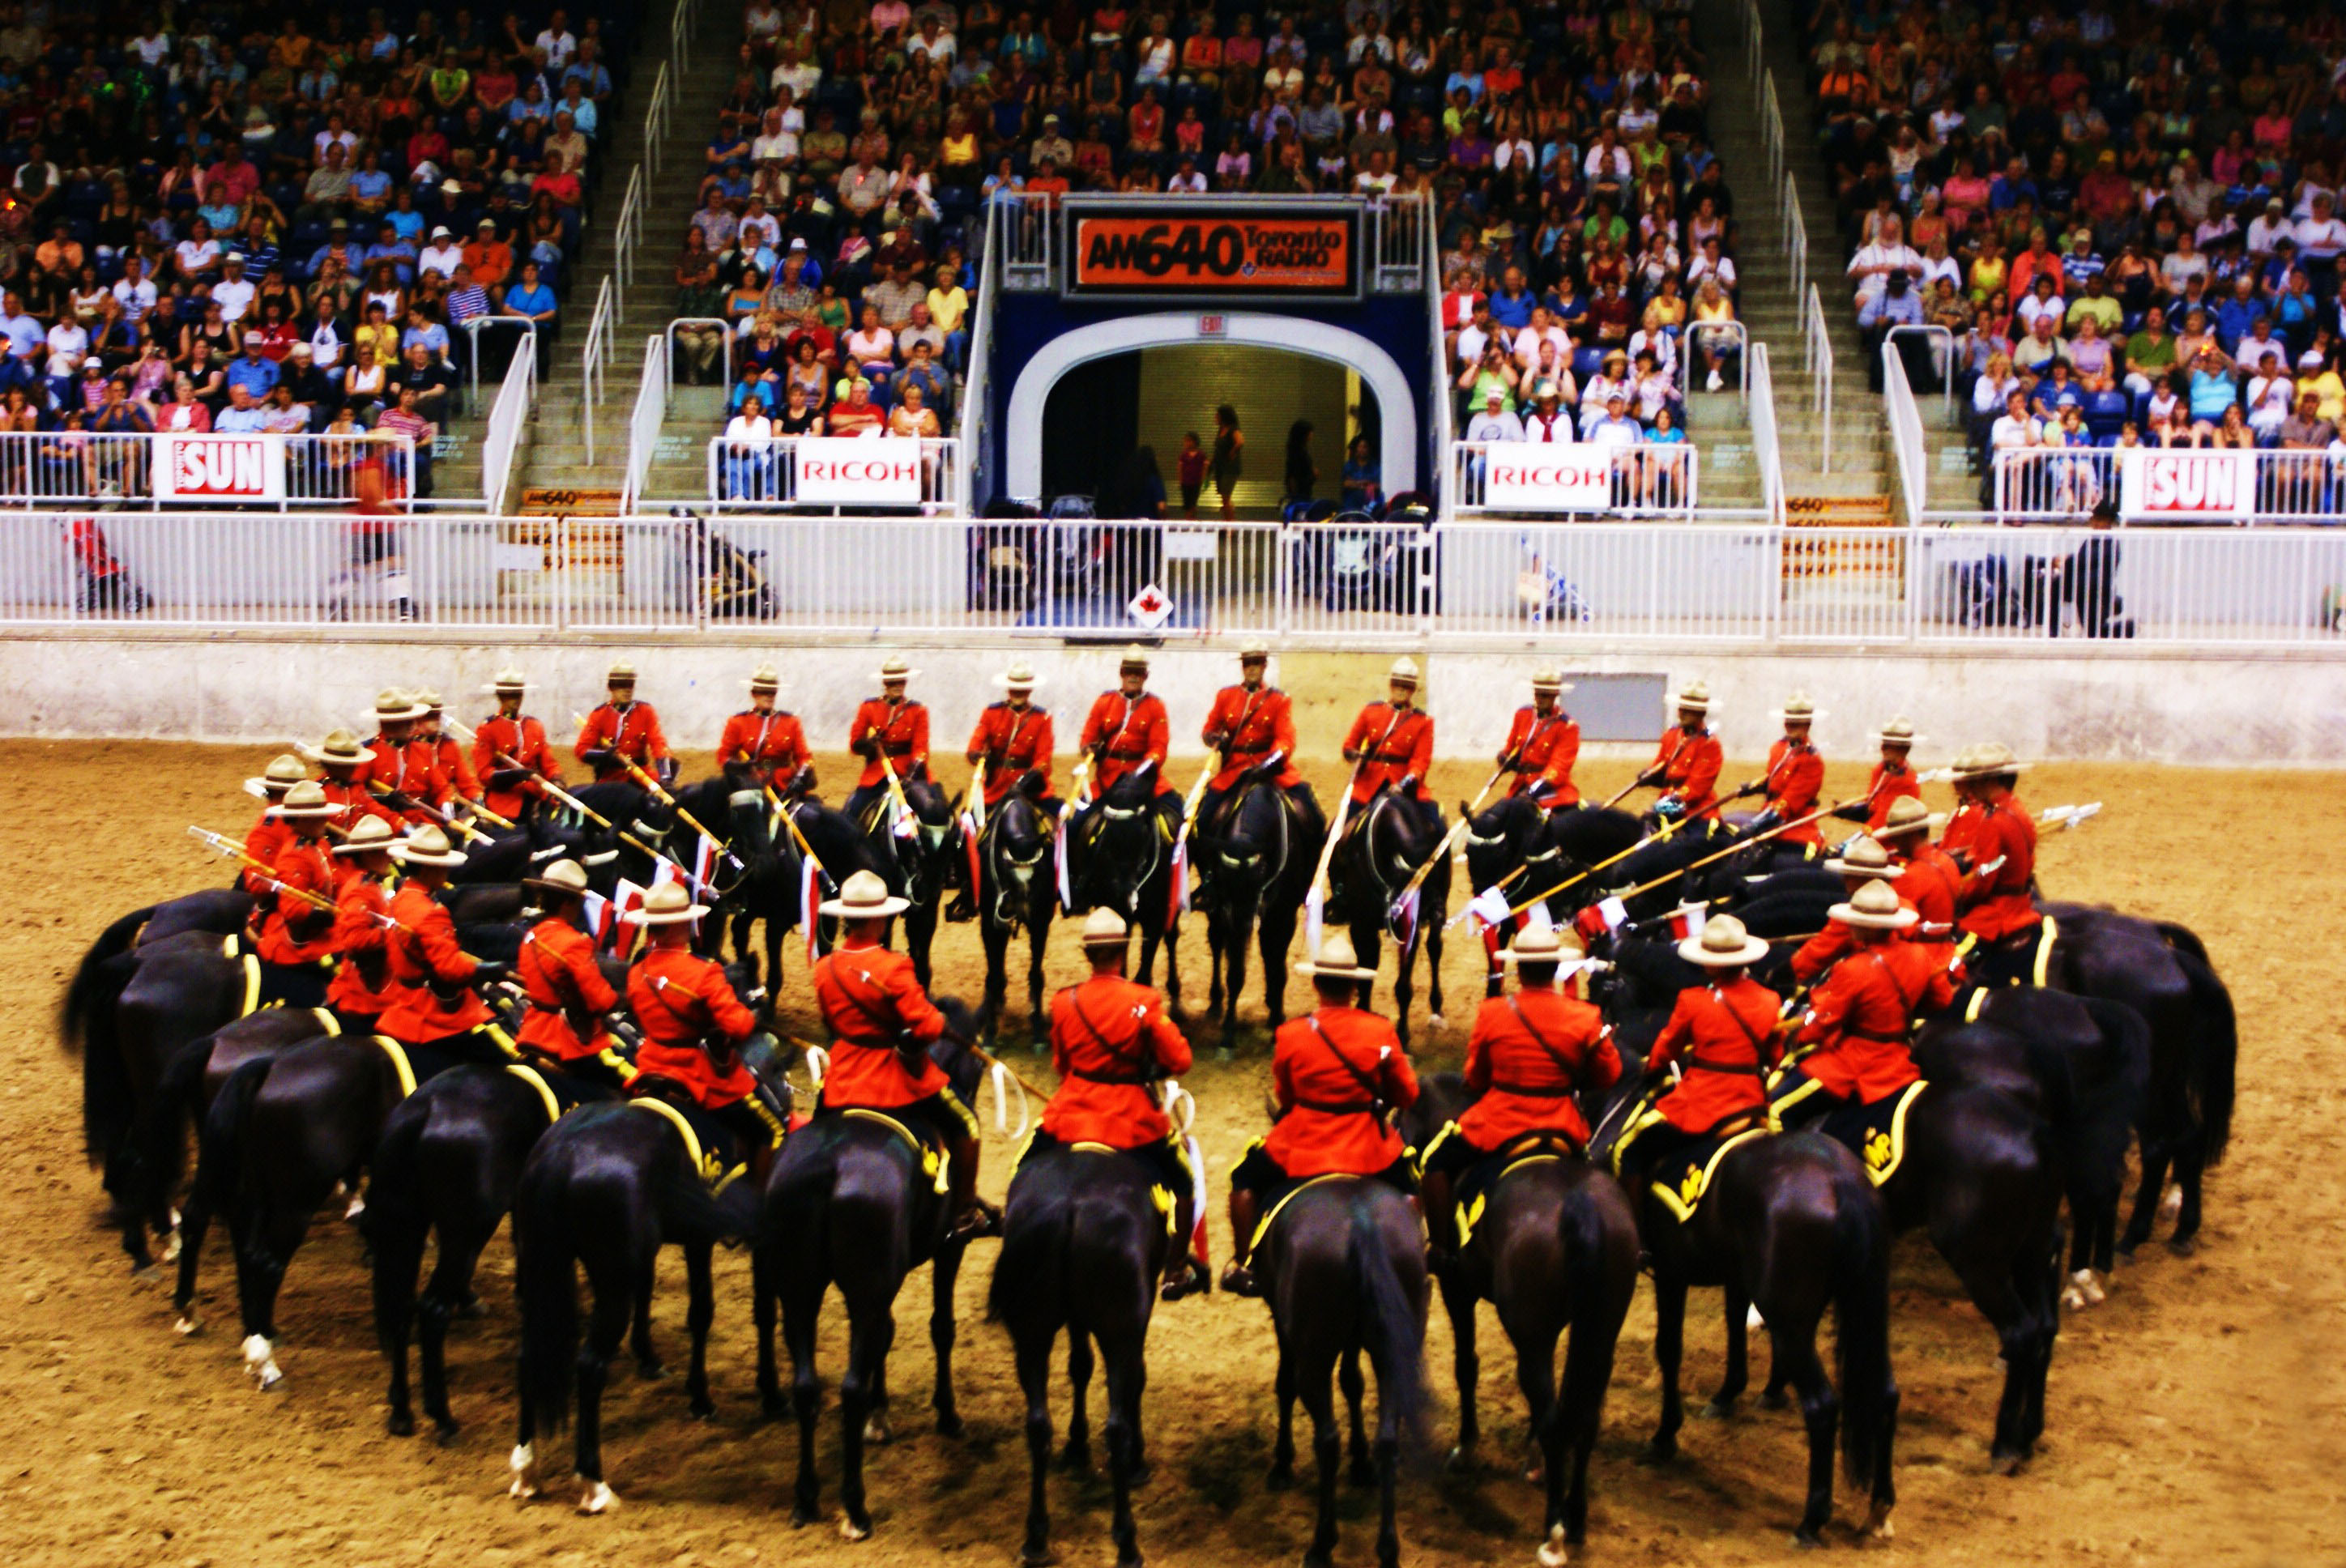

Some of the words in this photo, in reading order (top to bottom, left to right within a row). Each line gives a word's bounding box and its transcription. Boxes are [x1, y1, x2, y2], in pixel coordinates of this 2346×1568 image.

[1244, 225, 1341, 249] Toronto
[1257, 249, 1329, 266] RADIO
[1201, 316, 1222, 331] EXIT
[184, 441, 263, 491] SUN
[804, 461, 916, 480] RICOH
[1493, 466, 1606, 486] RICOH
[2153, 458, 2235, 507] SUN
